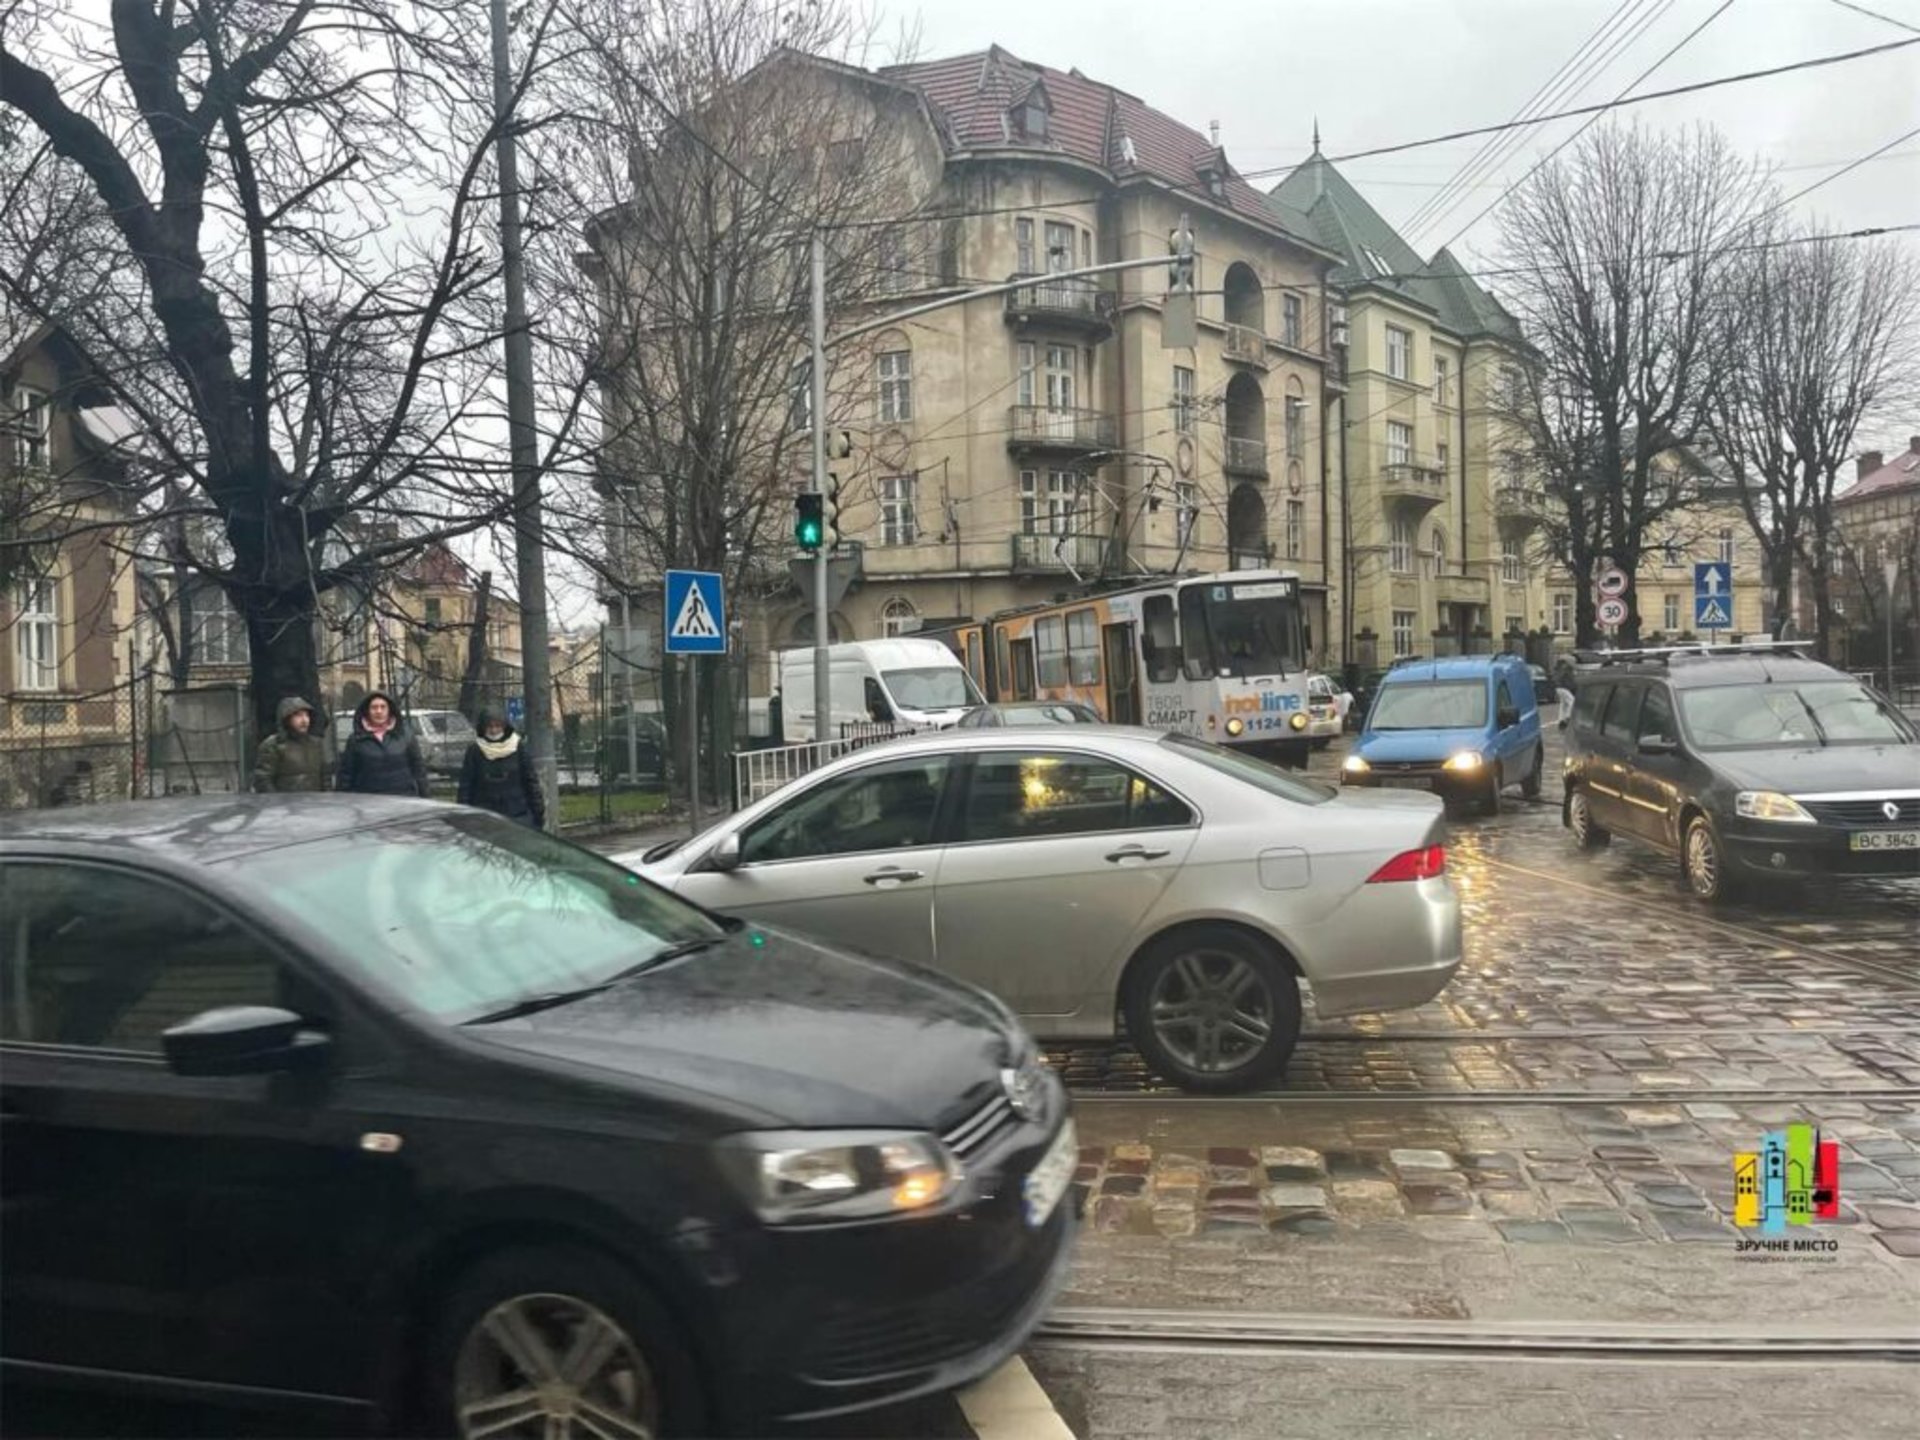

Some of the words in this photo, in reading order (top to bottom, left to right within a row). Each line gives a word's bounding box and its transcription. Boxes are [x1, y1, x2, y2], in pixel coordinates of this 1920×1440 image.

[1604, 605, 1621, 618] 30
[1225, 691, 1301, 713] hotline
[1147, 709, 1197, 725] СМАРТ
[1246, 717, 1282, 731] 1124
